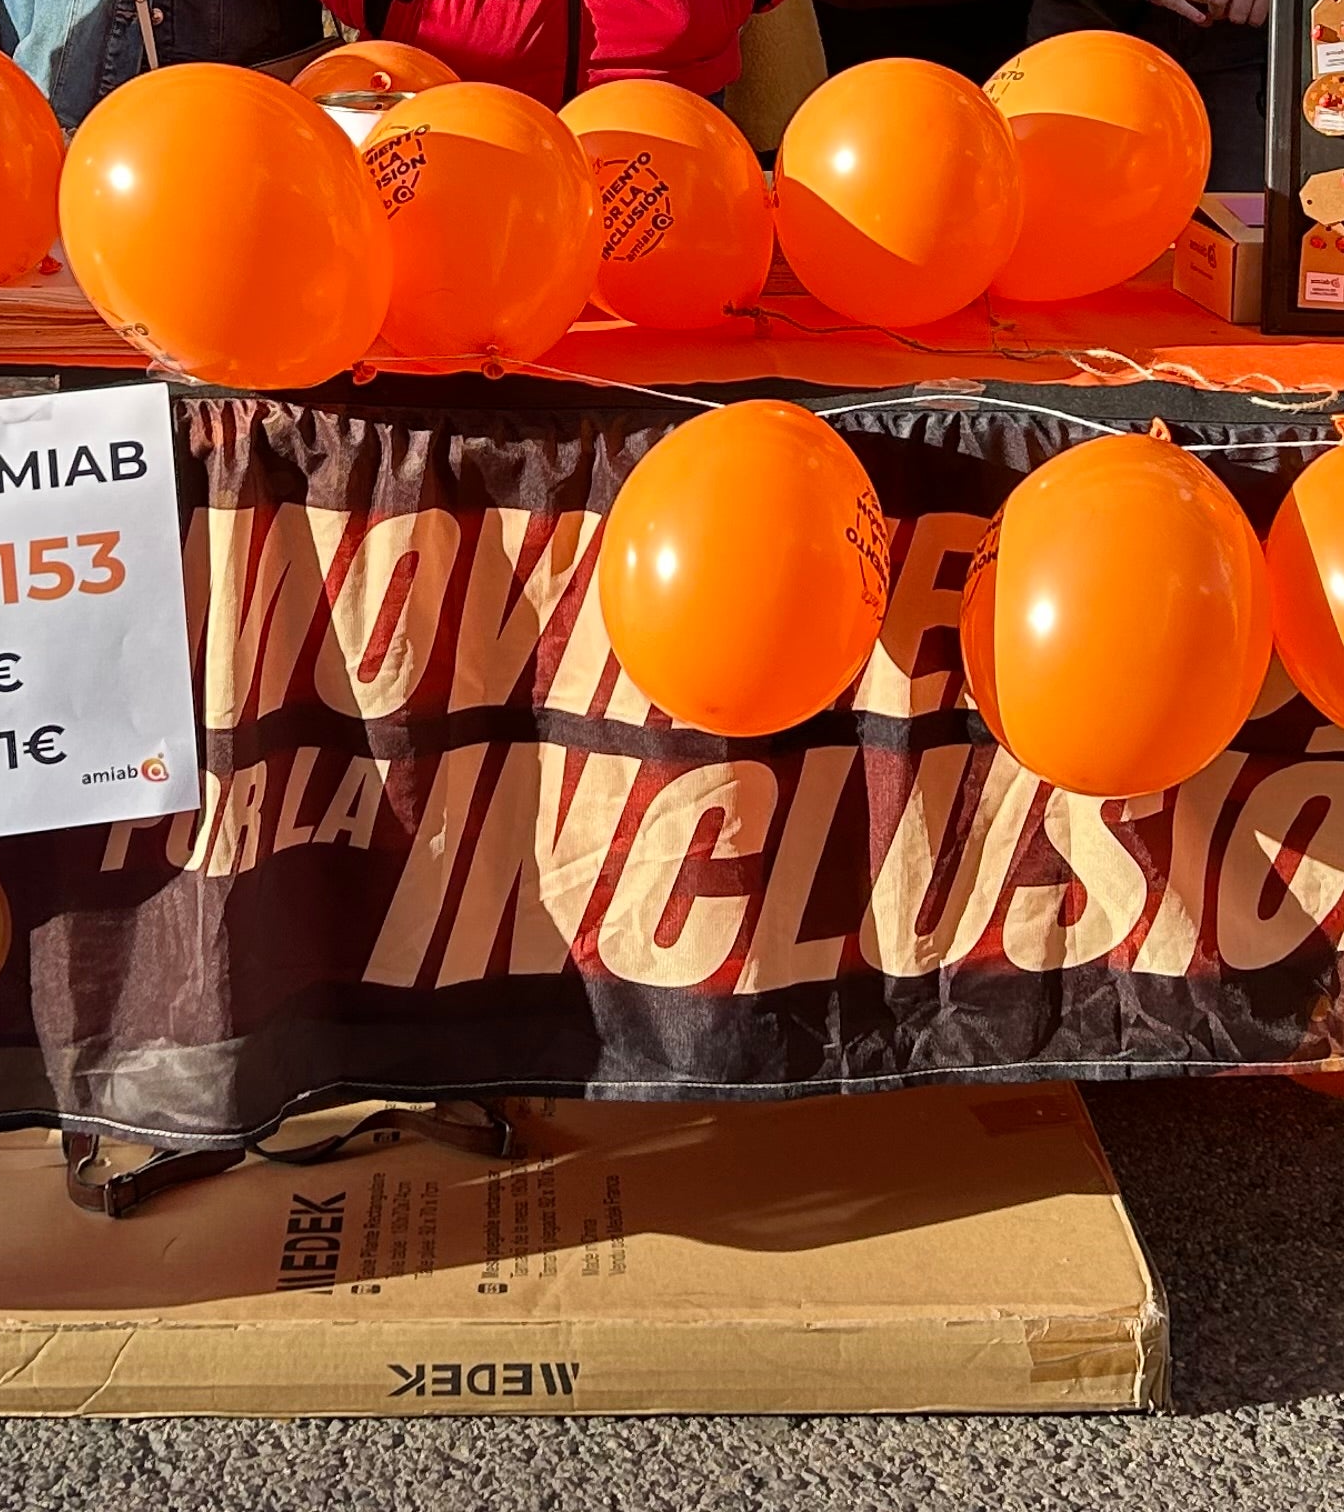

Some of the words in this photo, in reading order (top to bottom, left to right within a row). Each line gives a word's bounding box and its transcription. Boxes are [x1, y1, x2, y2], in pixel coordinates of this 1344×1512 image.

[604, 205, 624, 230] OR
[81, 763, 138, 786] amiab
[273, 745, 392, 854] LA
[386, 1362, 580, 1397] MEDEK
